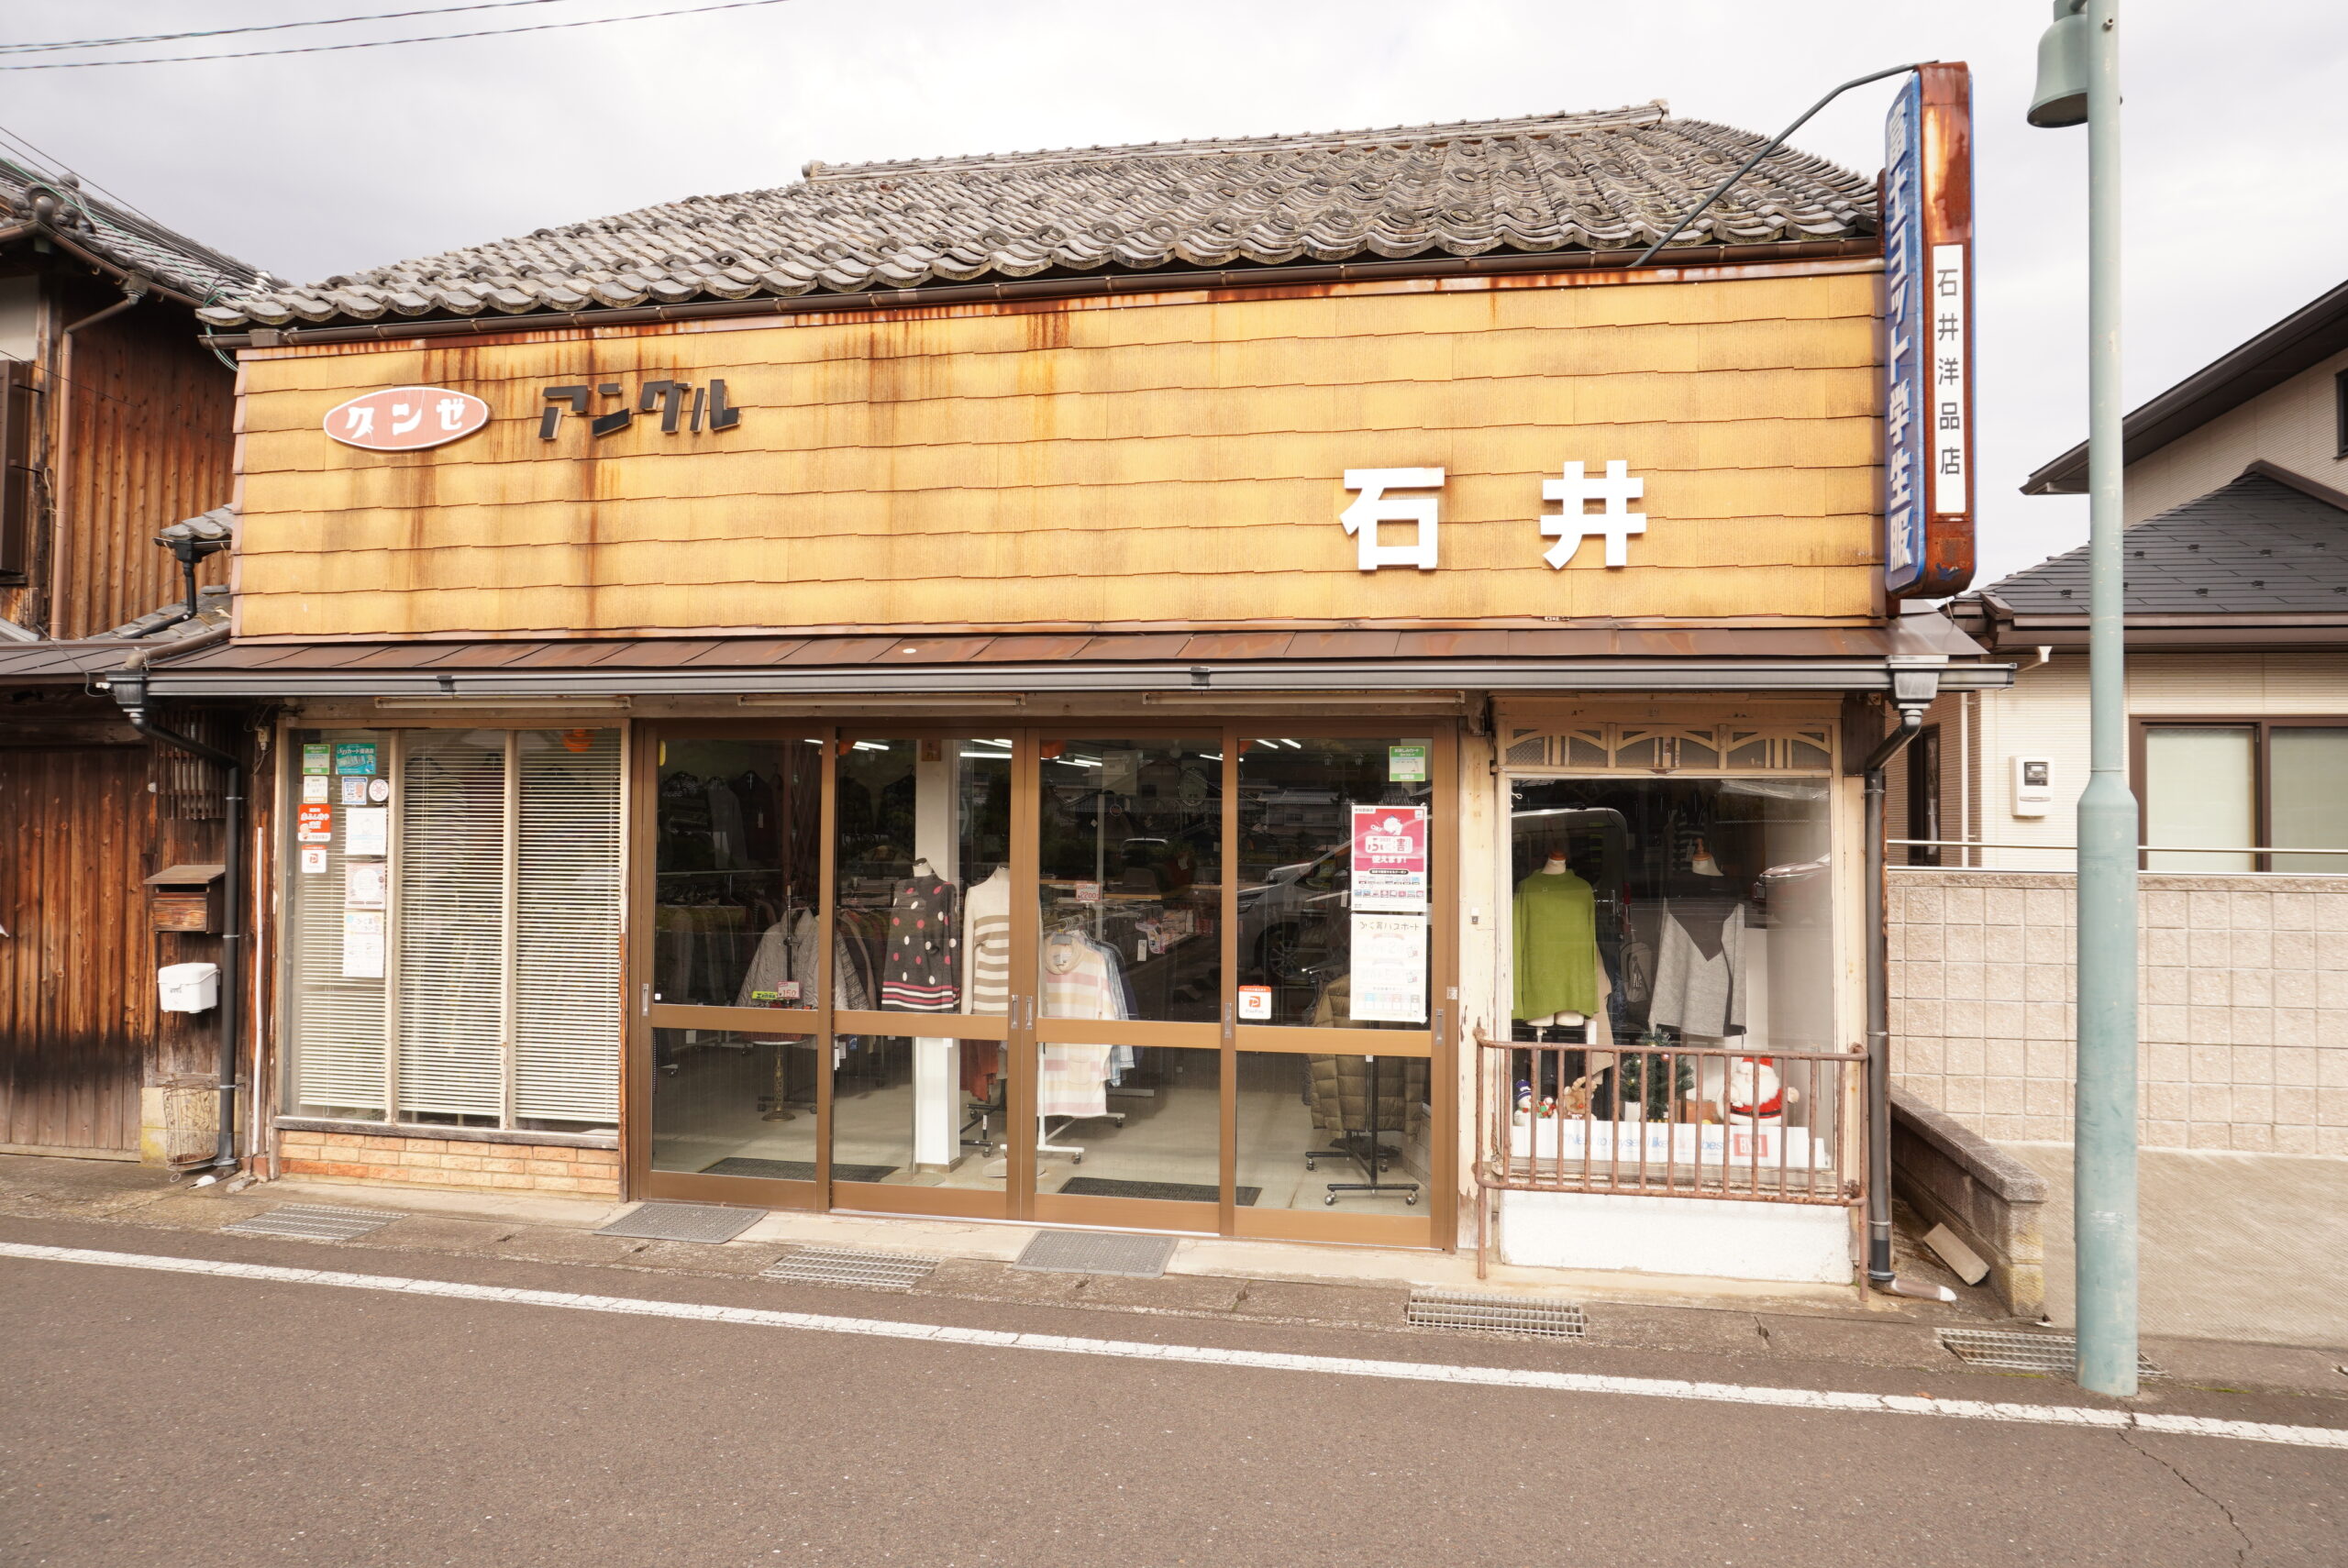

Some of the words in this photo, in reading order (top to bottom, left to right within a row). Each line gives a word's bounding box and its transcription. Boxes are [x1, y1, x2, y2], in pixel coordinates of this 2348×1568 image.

[1936, 268, 1960, 476] 石井洋品店
[346, 397, 466, 439] グンゼ
[539, 379, 742, 440] アングル
